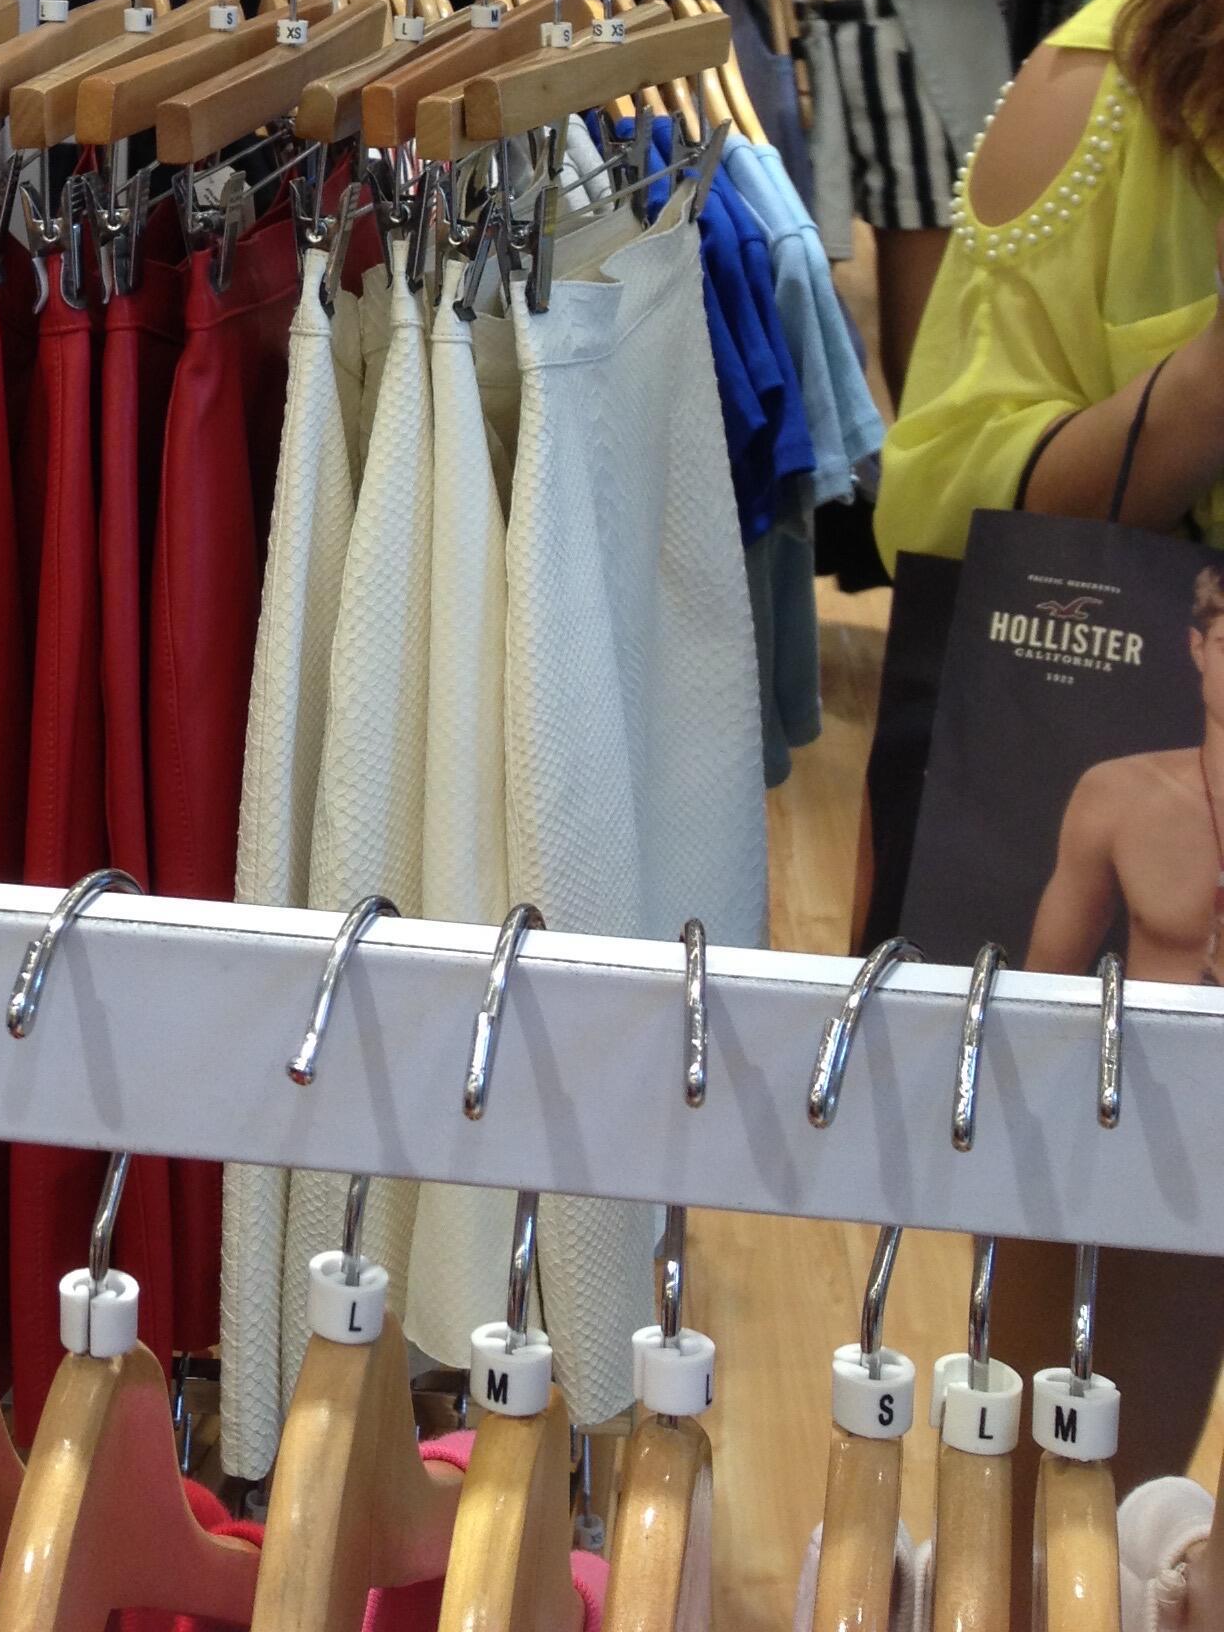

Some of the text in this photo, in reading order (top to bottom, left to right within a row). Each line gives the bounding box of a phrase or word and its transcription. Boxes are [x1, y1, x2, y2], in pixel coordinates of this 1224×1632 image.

[286, 26, 301, 39] XS
[563, 30, 570, 42] S
[611, 24, 624, 36] XS
[989, 611, 1144, 666] HOLLISTER
[1014, 647, 1113, 672] CALIFORNIA
[348, 1301, 362, 1333] L
[486, 1368, 509, 1406] M
[877, 1393, 895, 1427] S
[978, 1406, 994, 1441] L
[1053, 1404, 1078, 1444] M
